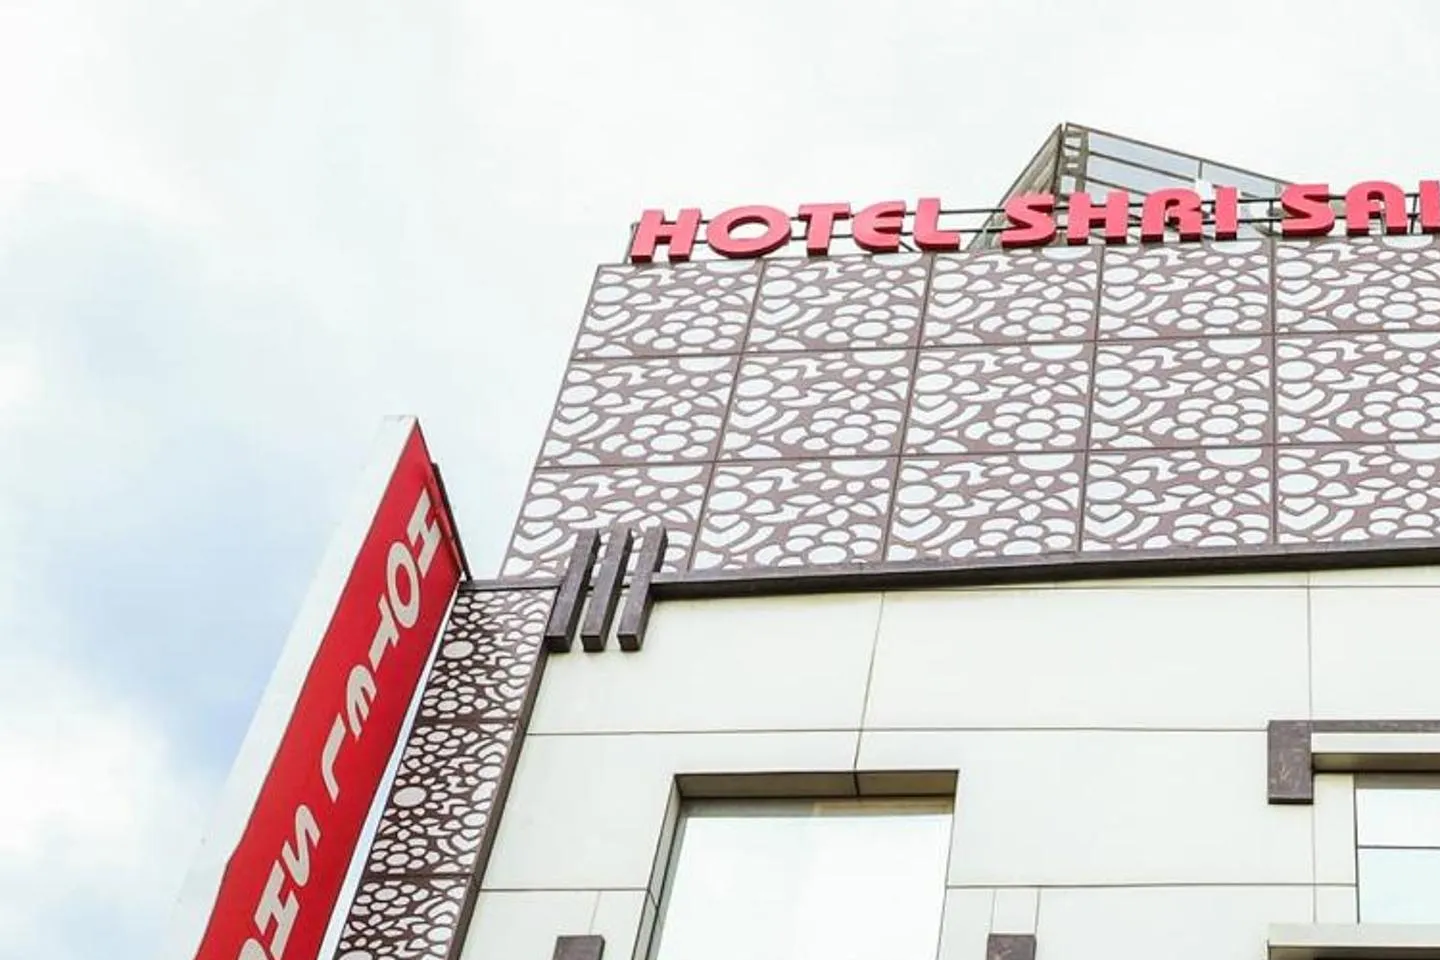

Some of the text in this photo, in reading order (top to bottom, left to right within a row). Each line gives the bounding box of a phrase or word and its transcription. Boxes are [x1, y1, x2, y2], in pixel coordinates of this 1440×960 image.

[631, 198, 960, 262] HOTEL
[1002, 186, 1238, 246] SHRI
[322, 489, 442, 803] HOTEL
